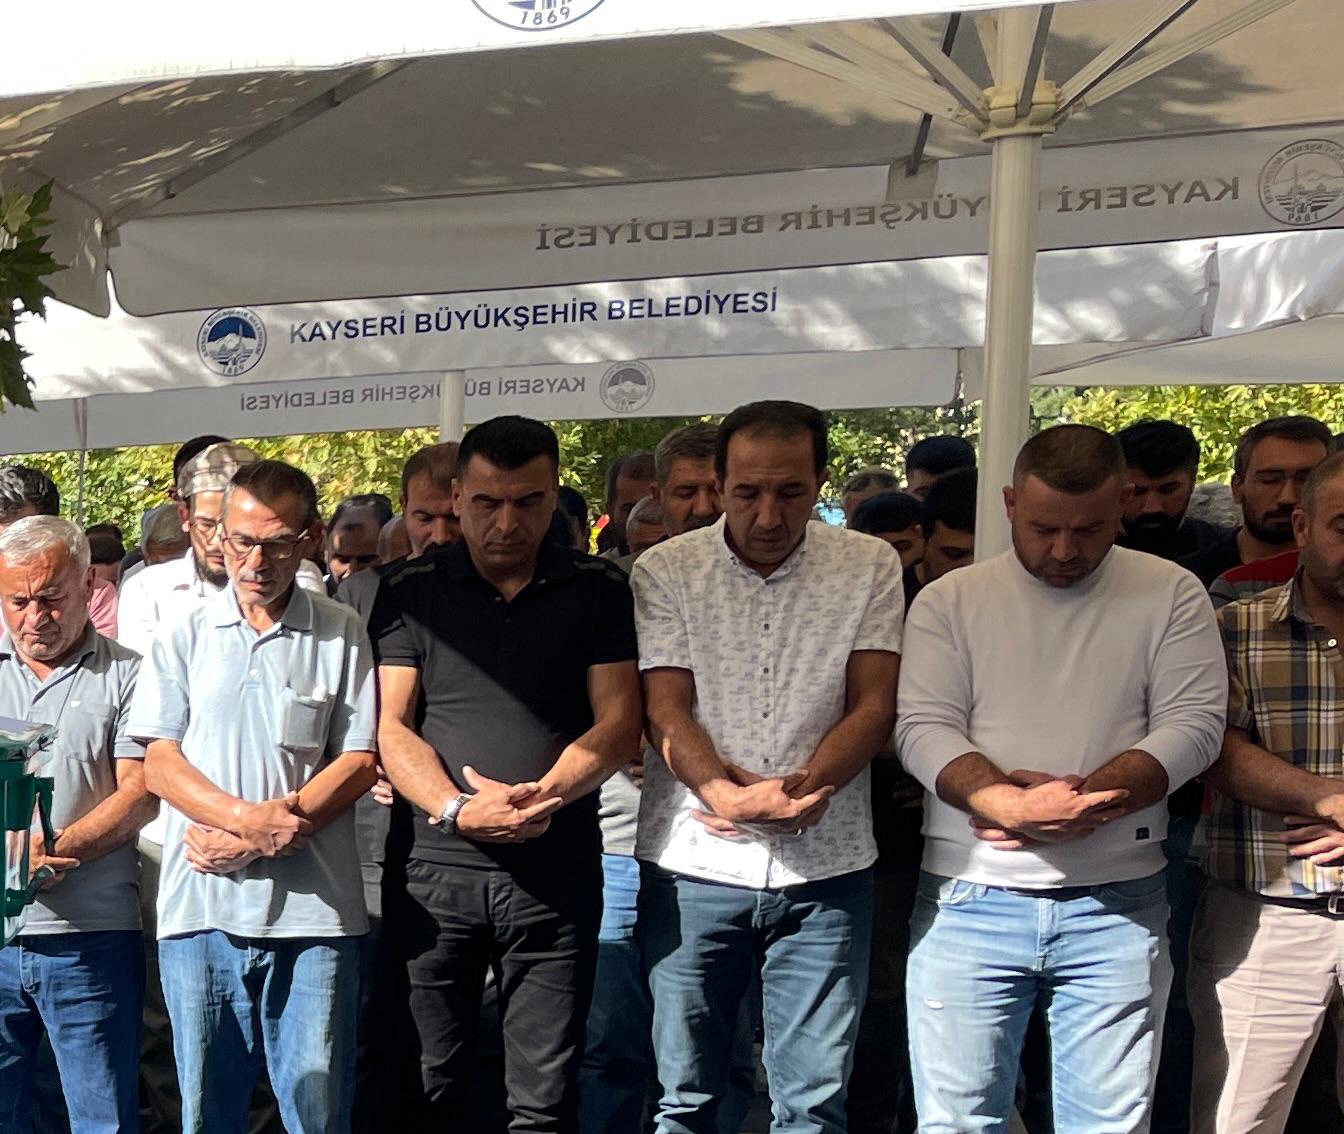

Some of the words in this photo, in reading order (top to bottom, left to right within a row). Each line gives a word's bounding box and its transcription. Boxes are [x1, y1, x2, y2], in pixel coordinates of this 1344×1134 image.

[520, 6, 570, 26] 1869
[289, 315, 406, 344] KAYSERİ
[414, 297, 599, 333] BÜYÜKŞEHİR
[607, 286, 779, 321] BELEDİYESİ
